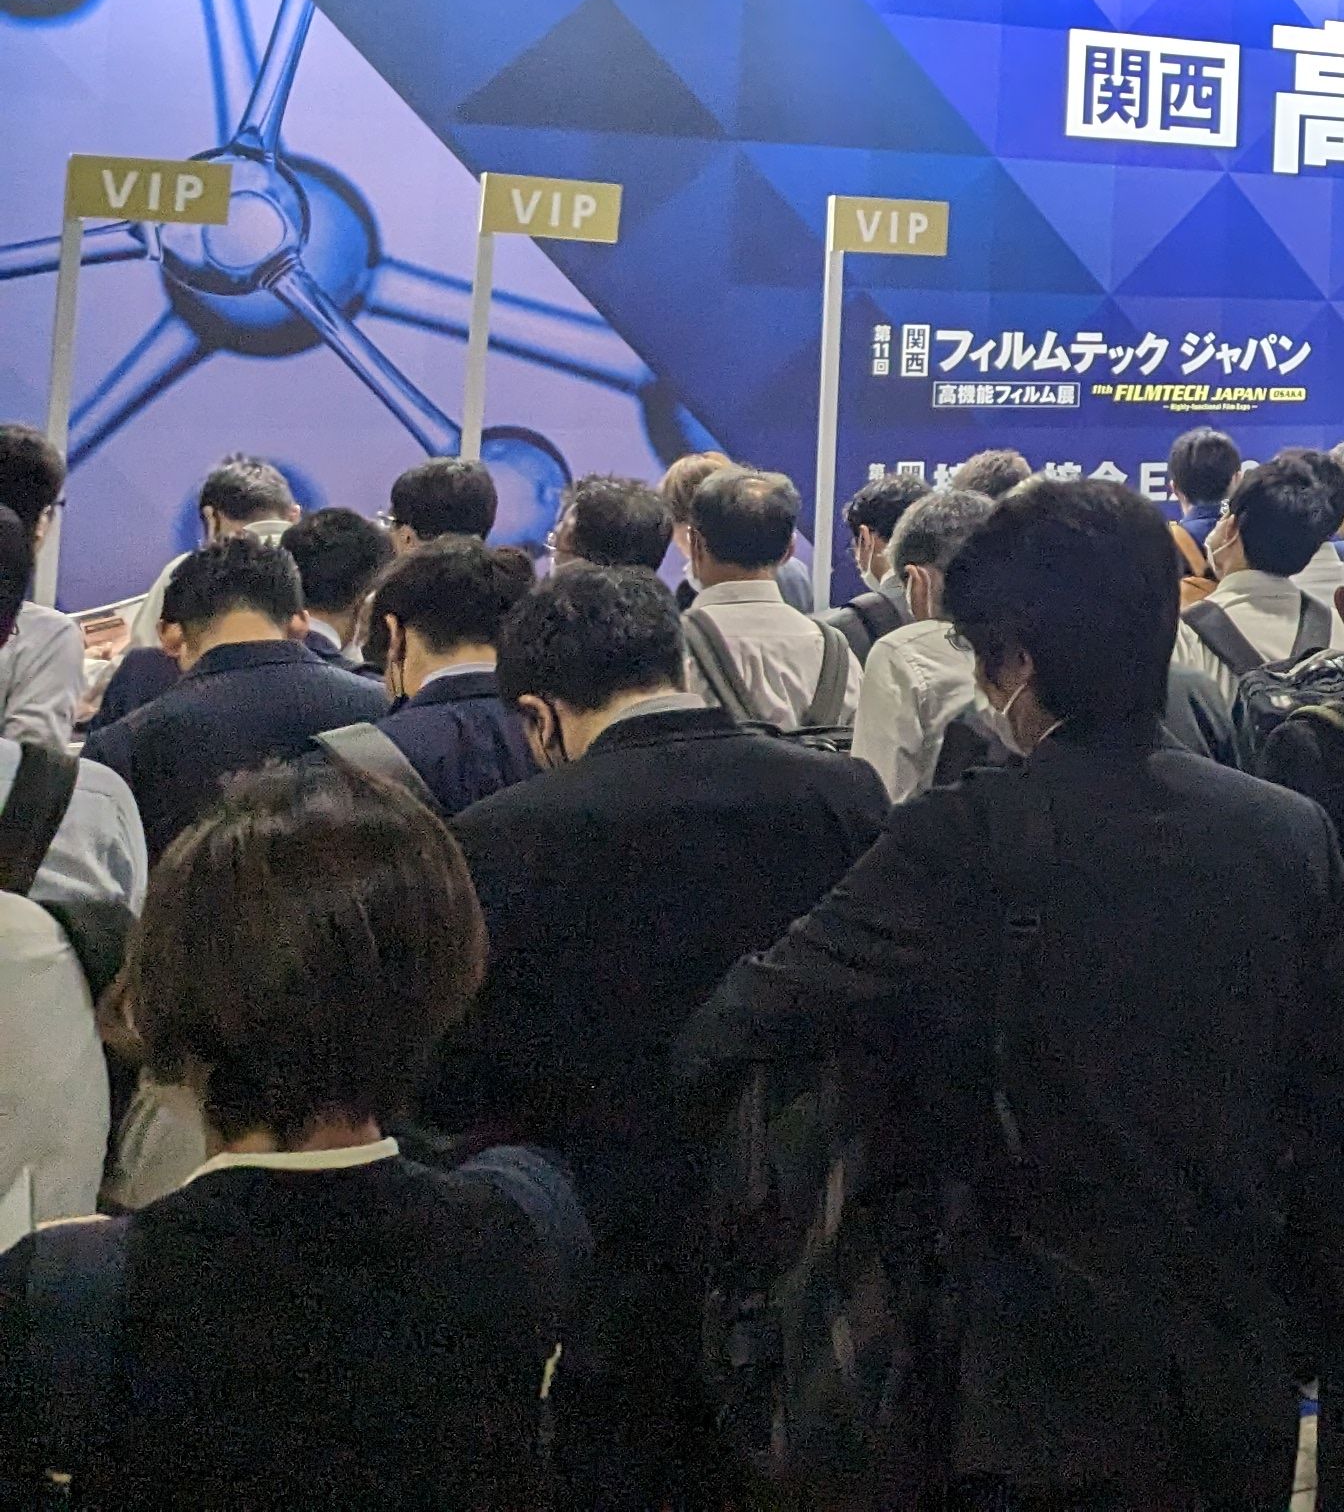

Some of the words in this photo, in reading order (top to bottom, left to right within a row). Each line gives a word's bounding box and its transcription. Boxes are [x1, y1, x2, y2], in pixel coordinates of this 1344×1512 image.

[1082, 44, 1228, 134] 関西
[101, 169, 205, 215] VIP
[510, 190, 597, 230] VIP
[855, 210, 930, 245] VIP
[872, 324, 891, 376] 第11回
[905, 328, 926, 374] 関西
[935, 330, 1170, 374] フィルムテック
[1180, 332, 1312, 375] ジャパン
[938, 384, 1076, 405] 高機能フィルム展
[1113, 384, 1211, 402] FILMTECH
[1211, 387, 1269, 402] JAPAN
